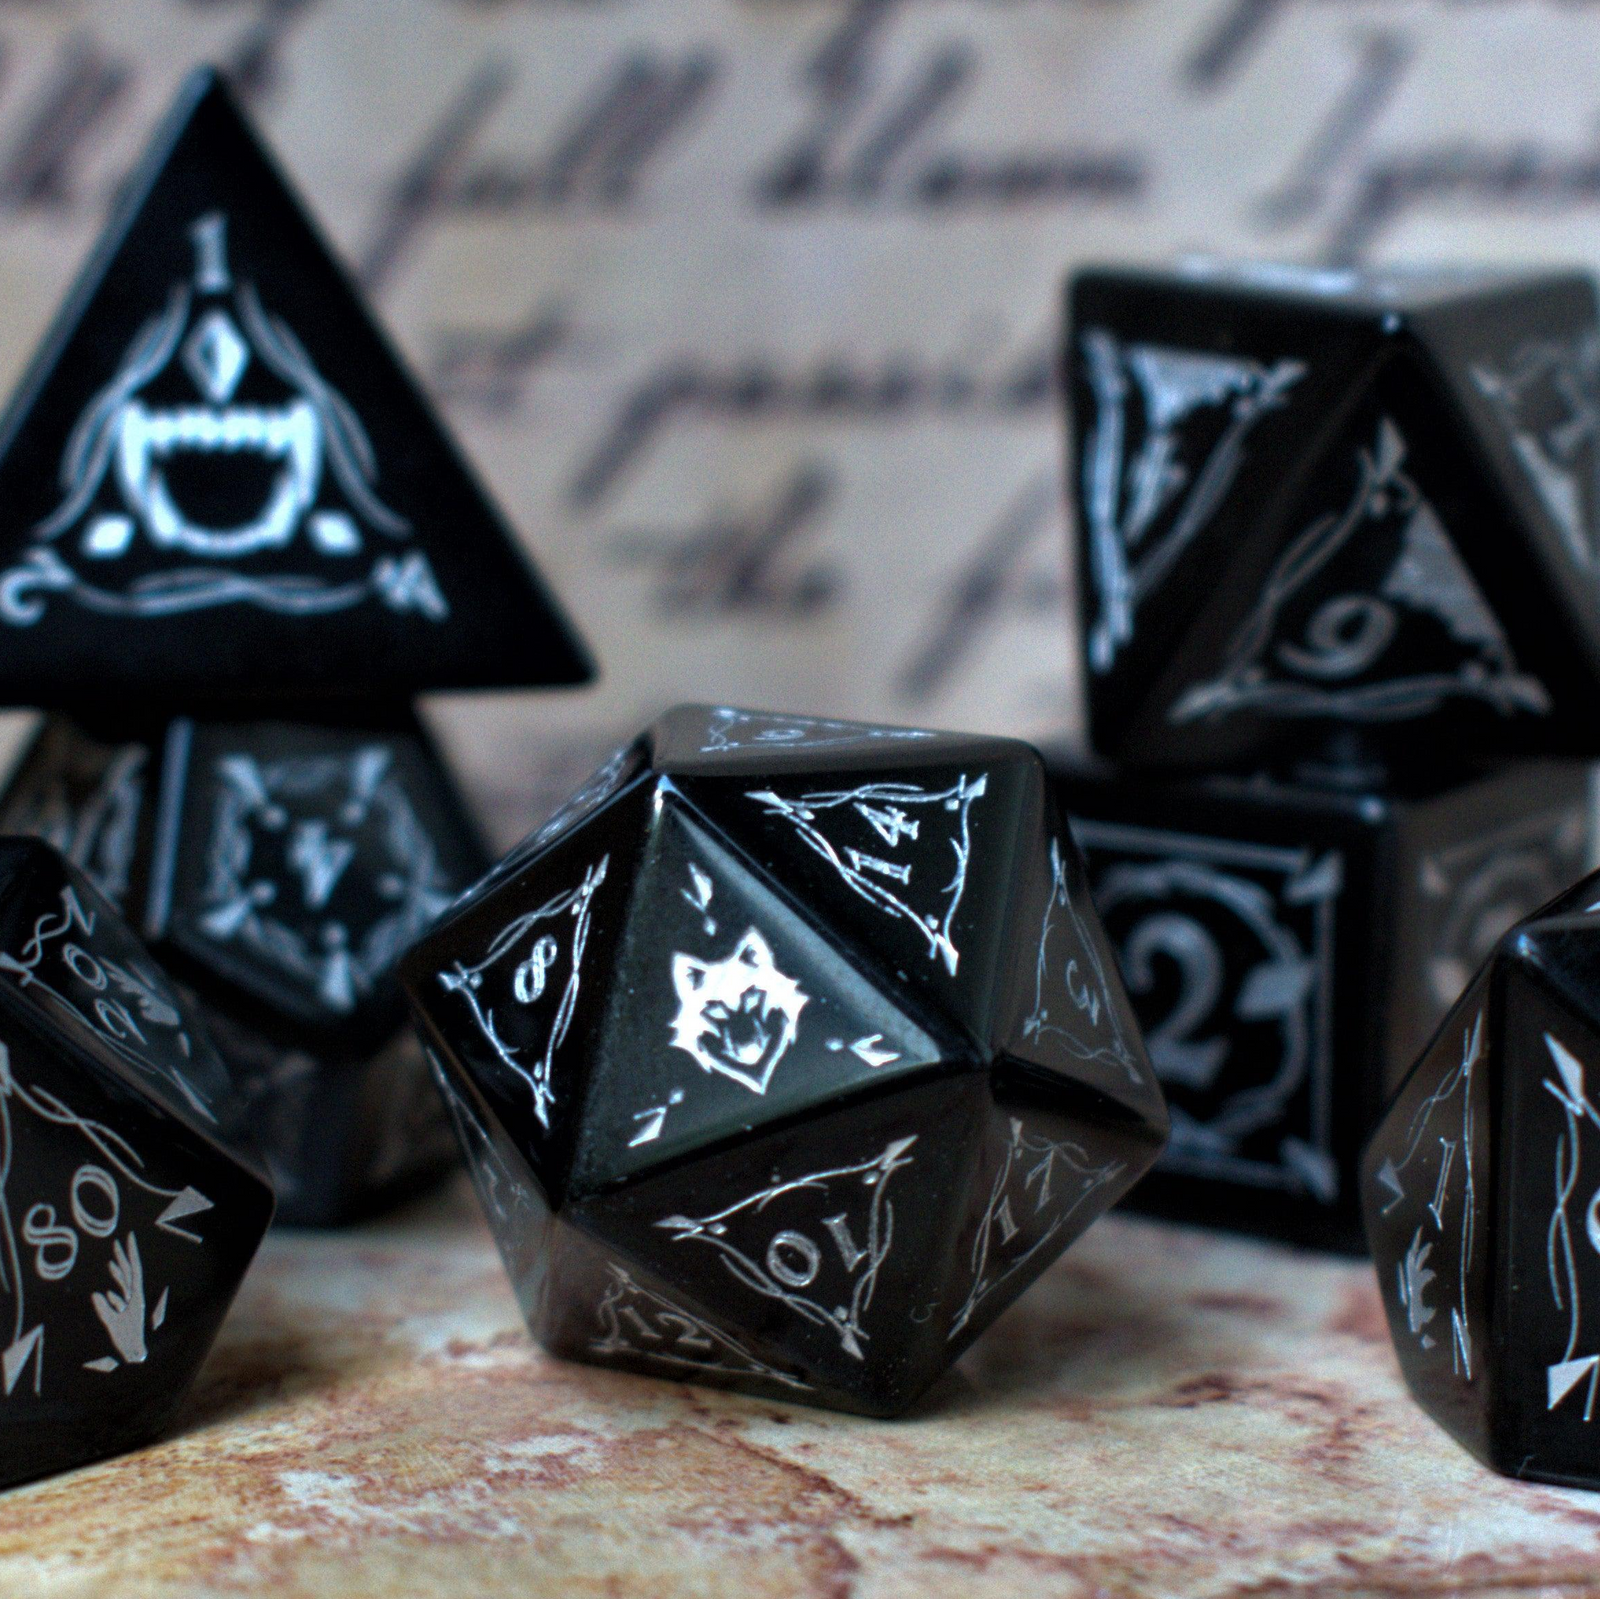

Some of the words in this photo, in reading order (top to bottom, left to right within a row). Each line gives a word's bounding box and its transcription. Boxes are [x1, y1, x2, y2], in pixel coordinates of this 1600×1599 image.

[191, 212, 231, 291] 1
[843, 801, 919, 885] 14
[513, 933, 558, 1003] 8
[1125, 911, 1230, 1085] 2
[22, 1163, 120, 1281] 80
[619, 1305, 713, 1349] 12
